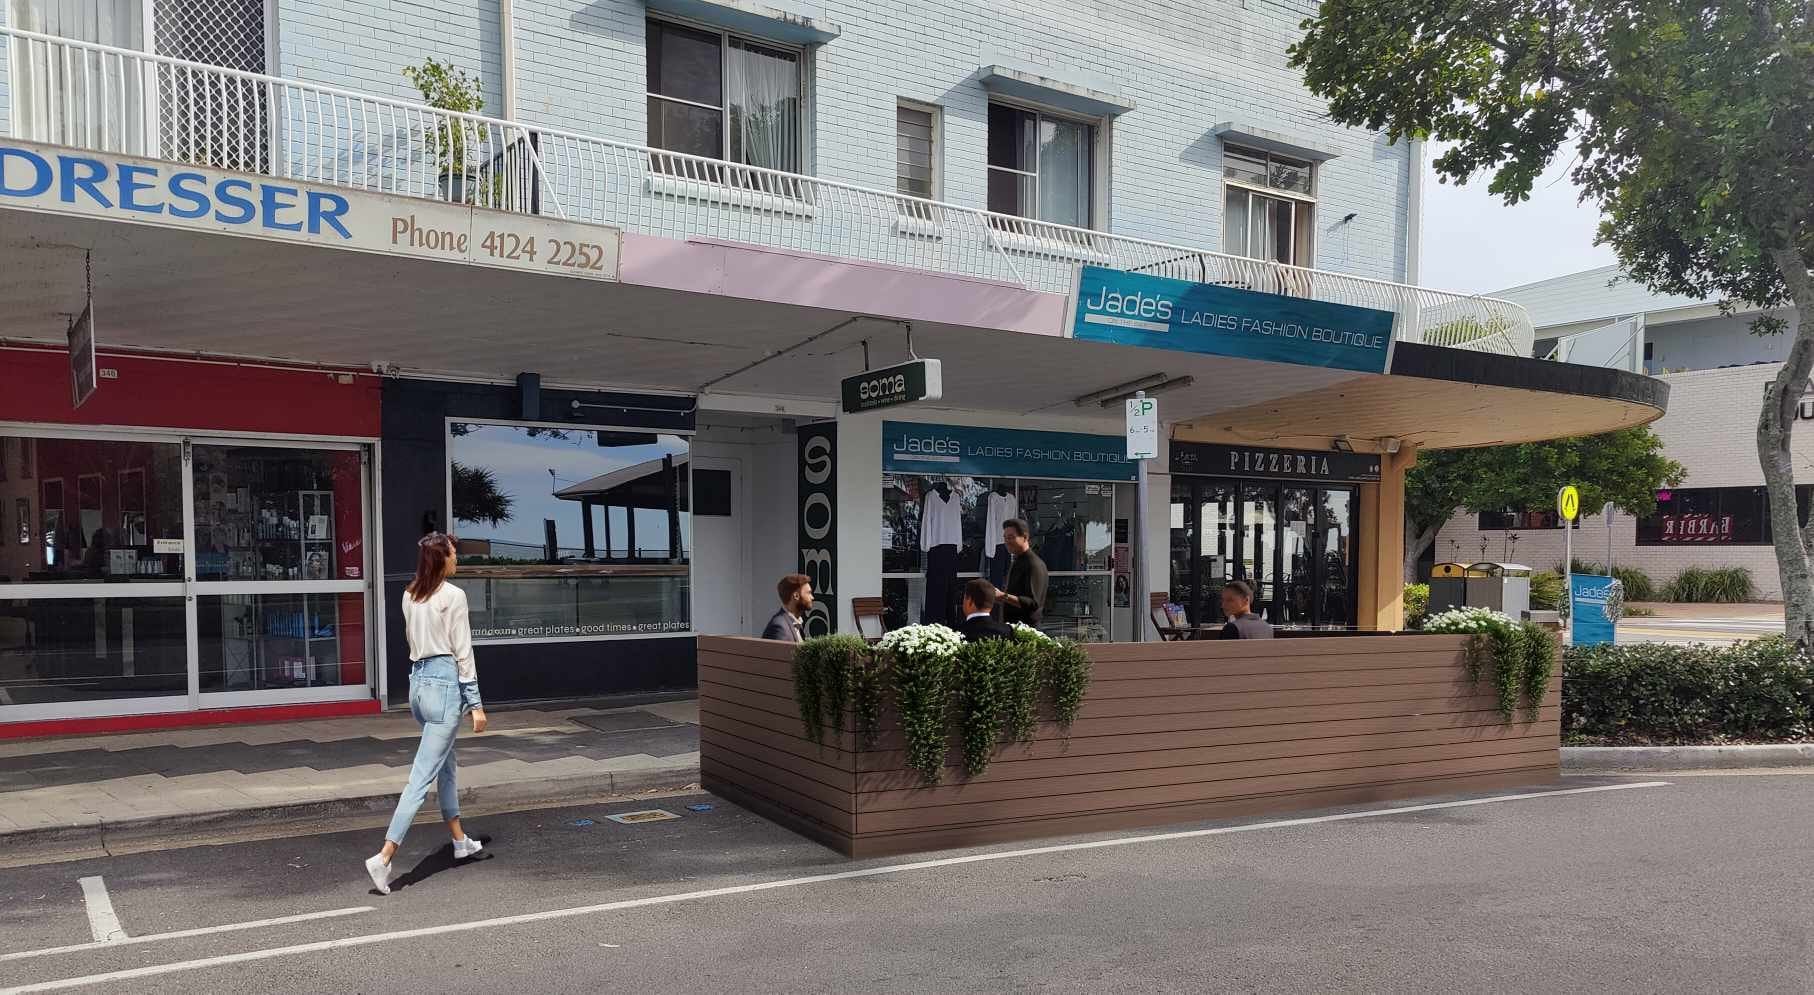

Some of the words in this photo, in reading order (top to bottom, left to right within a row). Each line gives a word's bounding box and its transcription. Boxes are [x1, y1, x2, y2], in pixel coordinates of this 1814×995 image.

[0, 148, 352, 239] DRESSER
[391, 214, 468, 253] Phone
[481, 231, 537, 262] 4124
[547, 239, 603, 271] 2252
[1086, 286, 1173, 320] Jade's
[1181, 309, 1237, 331] LADIES
[1241, 318, 1309, 340] FASHION
[1311, 327, 1384, 350] BOUTIQUE
[860, 375, 905, 400] soma
[893, 433, 960, 454] Jade's
[967, 446, 1013, 458] LADIES
[1016, 447, 1071, 462] FASHION
[1230, 451, 1330, 475] PIZZERIA
[517, 625, 543, 636] great
[545, 624, 575, 636] plates
[581, 623, 605, 635] good
[606, 623, 632, 633] times
[637, 621, 662, 633] great
[663, 620, 690, 632] plates
